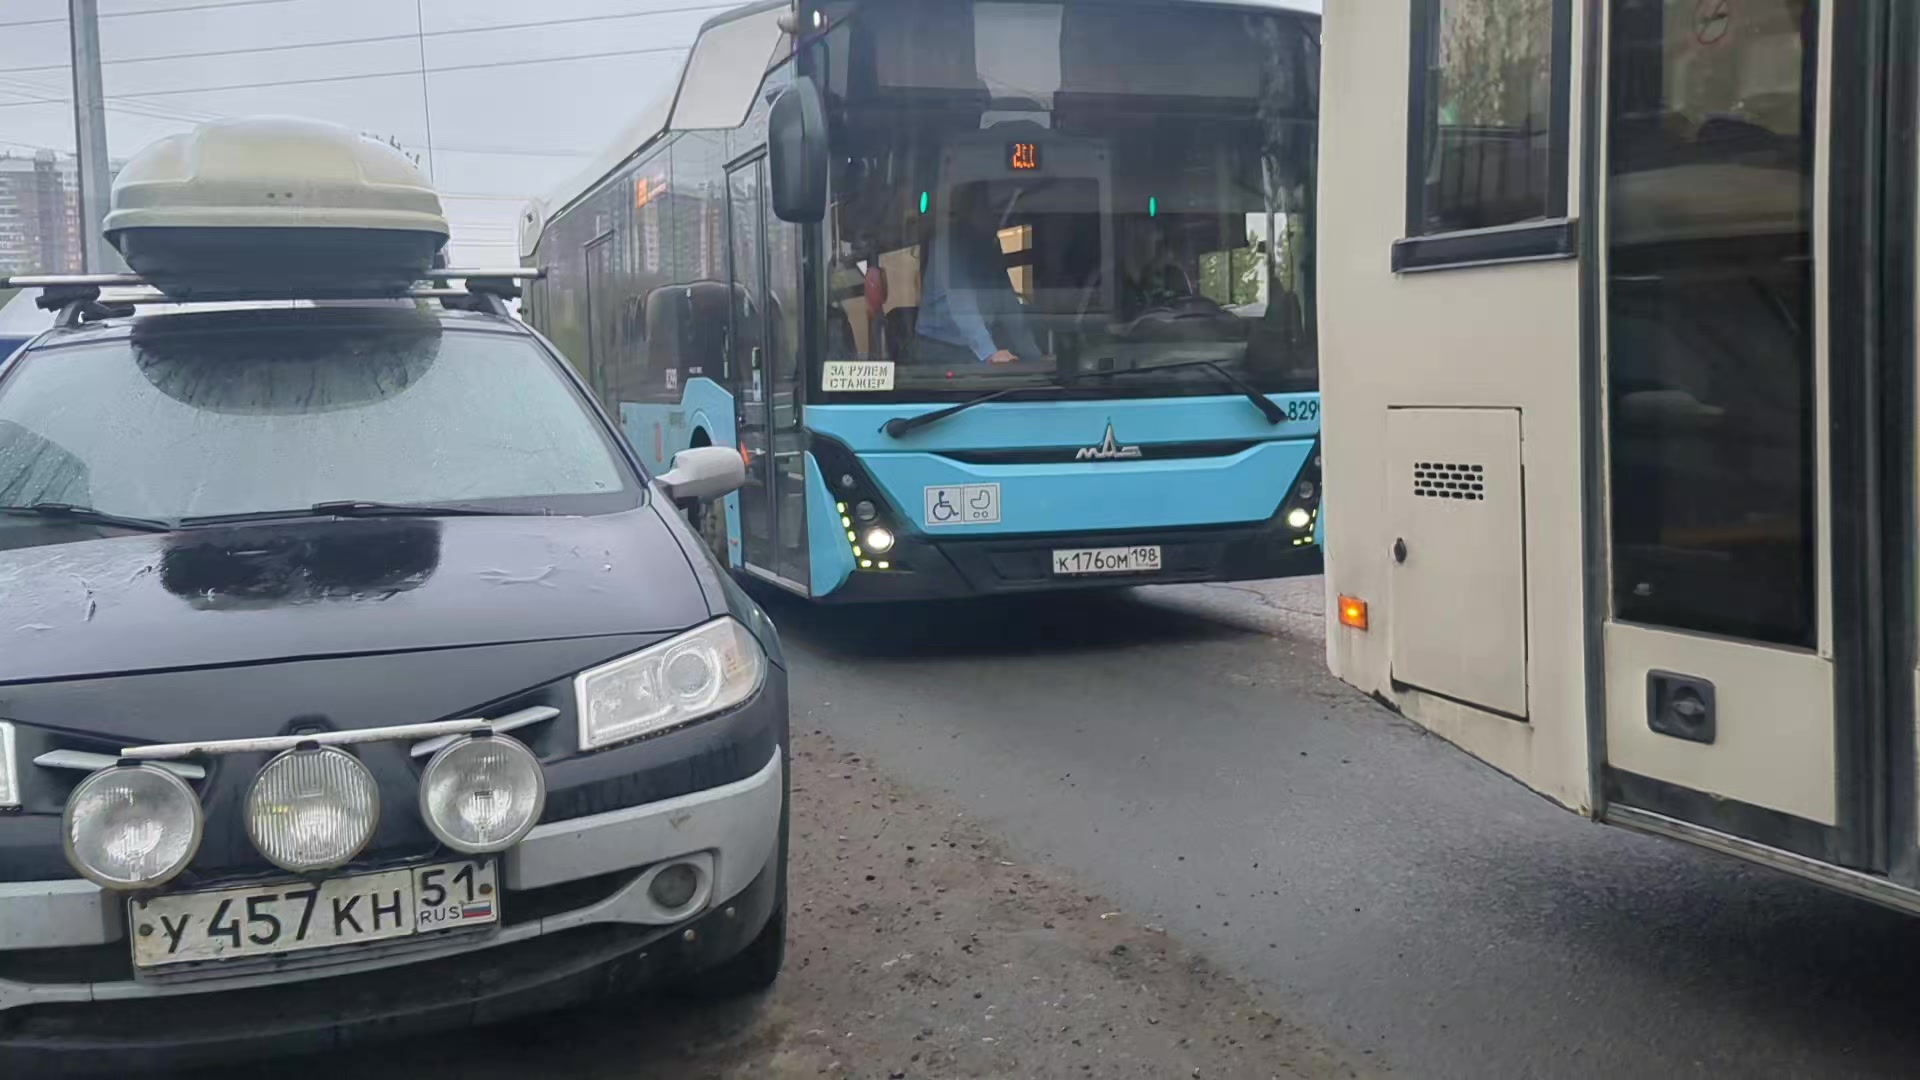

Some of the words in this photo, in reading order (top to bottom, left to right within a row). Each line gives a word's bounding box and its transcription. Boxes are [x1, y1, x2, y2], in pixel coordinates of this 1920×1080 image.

[830, 365, 845, 376] ЗА
[848, 365, 888, 377] РУЛЕМ
[829, 378, 886, 389] СТАЖЕР
[1288, 400, 1320, 421] 829
[1131, 547, 1158, 563] 198
[420, 863, 476, 907] 51
[420, 905, 460, 924] RUS
